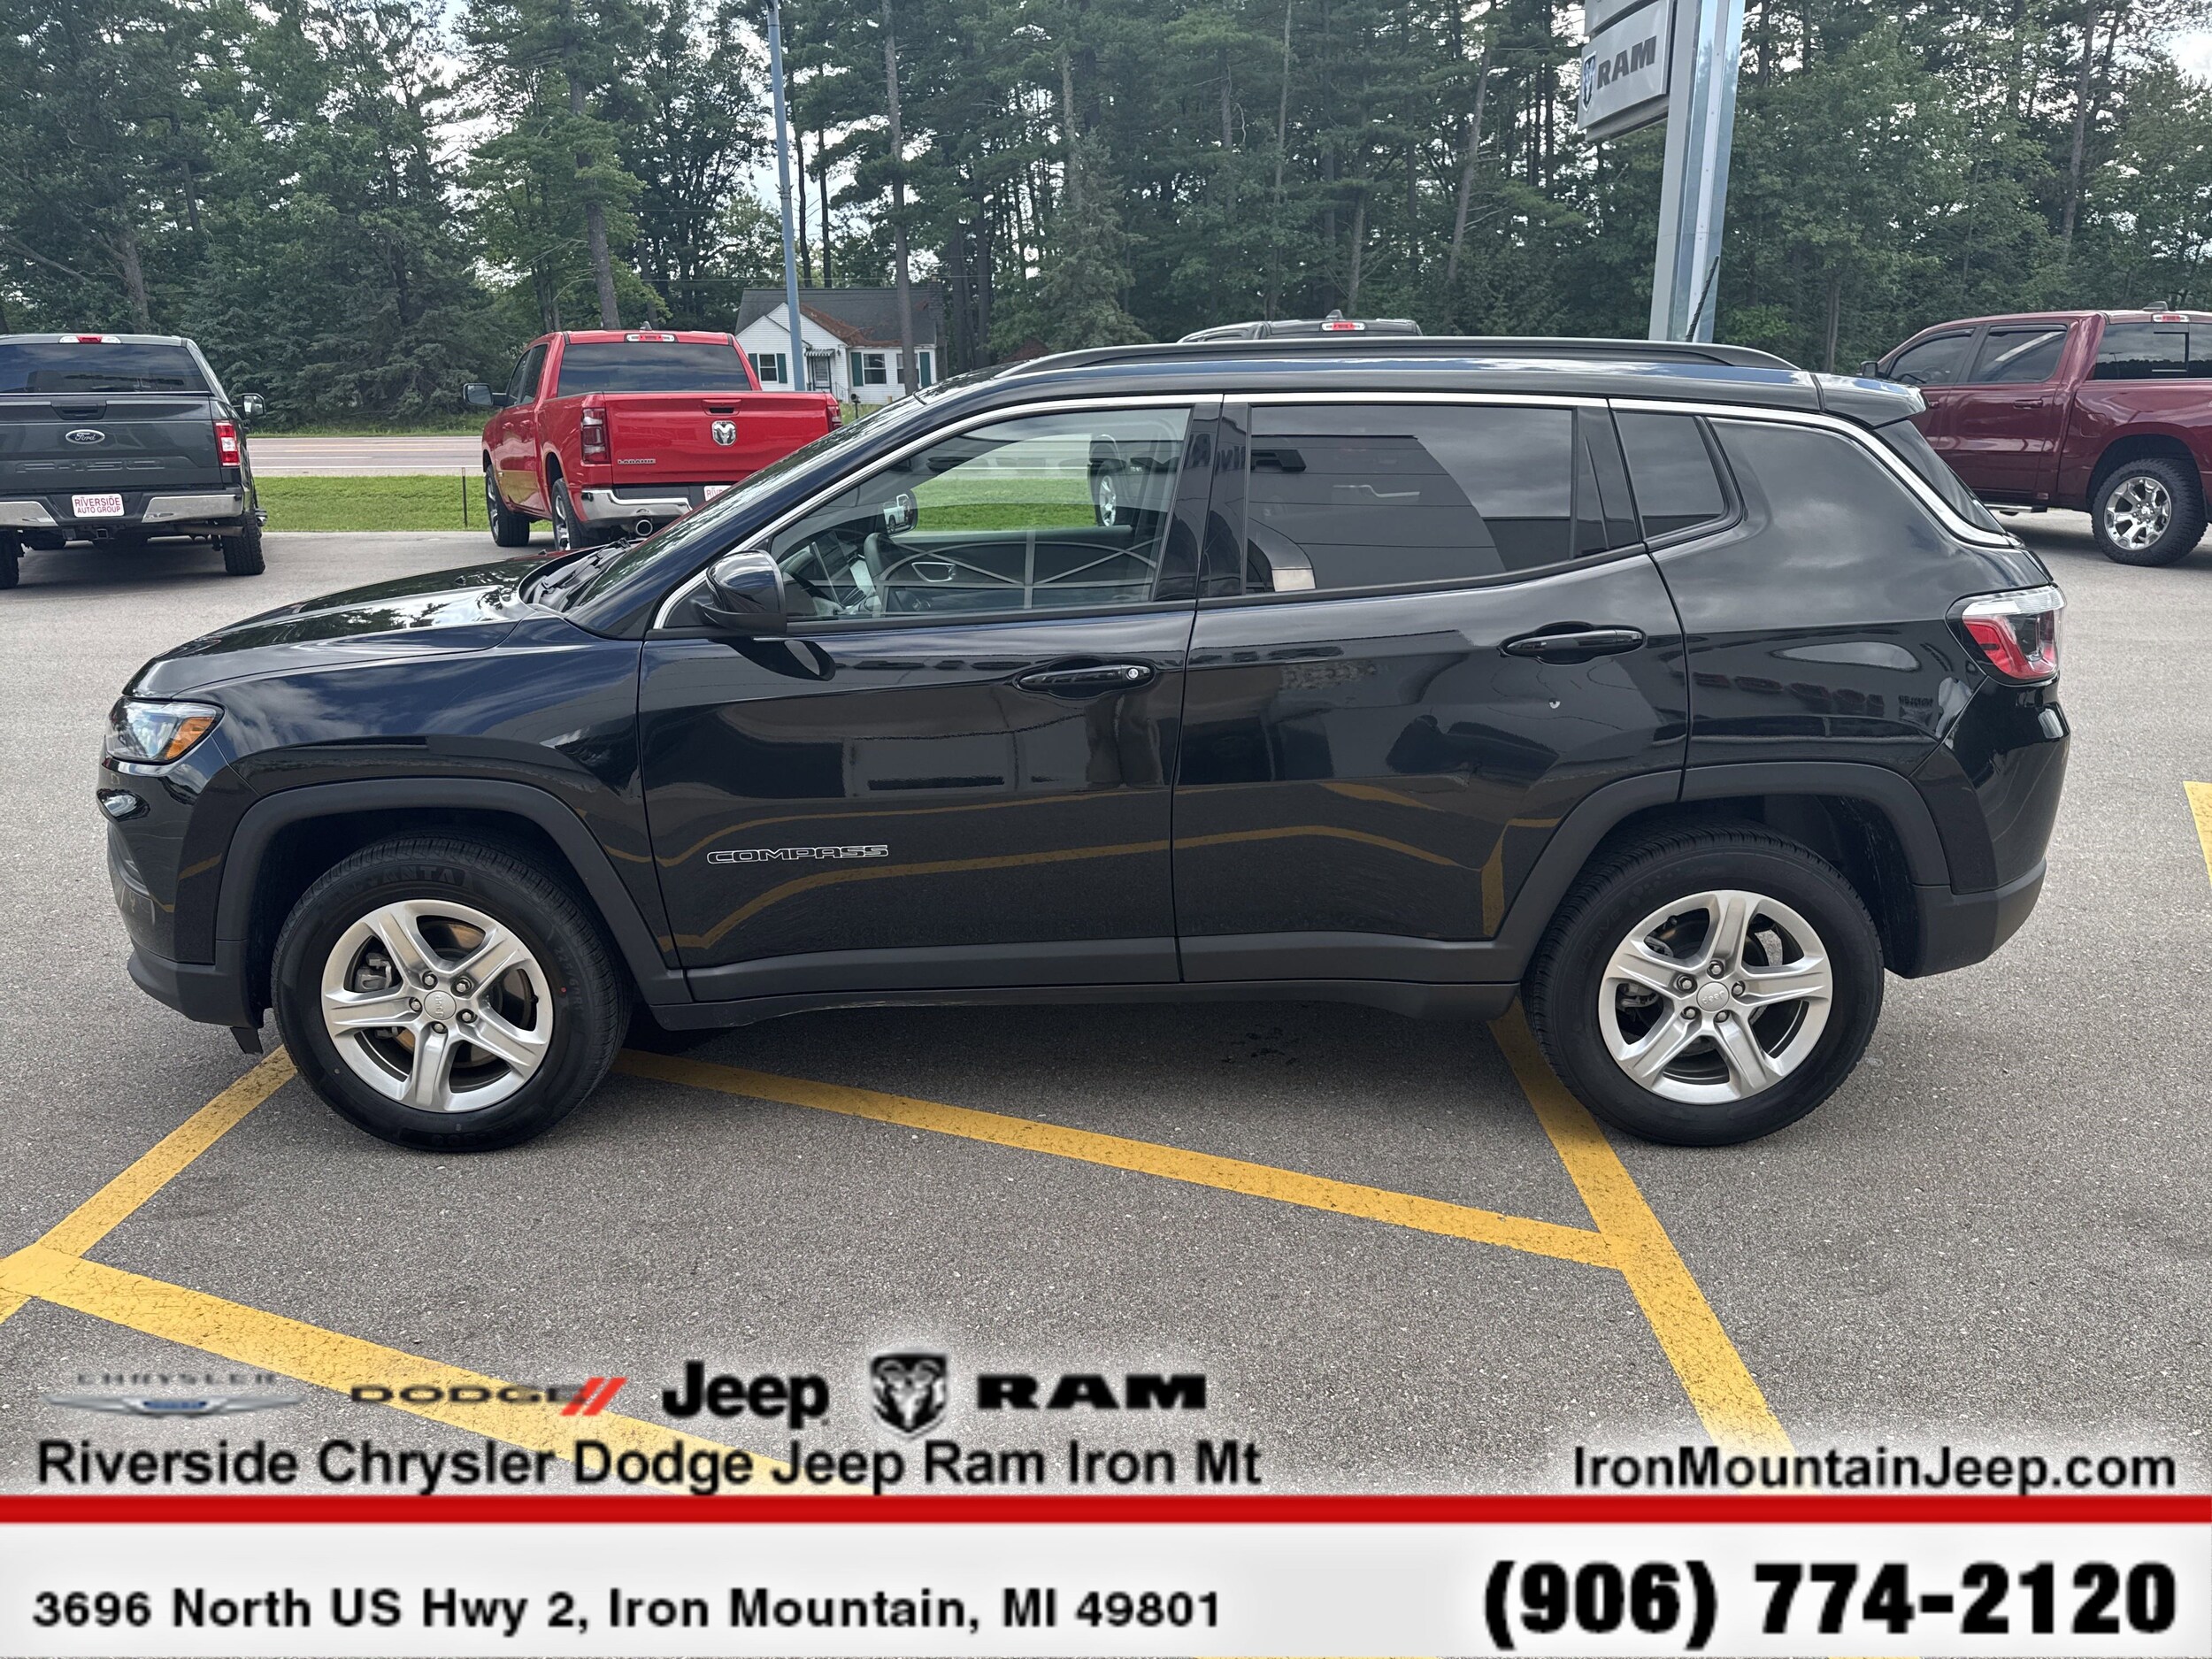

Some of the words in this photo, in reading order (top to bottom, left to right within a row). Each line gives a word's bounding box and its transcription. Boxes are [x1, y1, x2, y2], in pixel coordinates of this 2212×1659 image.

[1596, 35, 1657, 90] RAM
[74, 496, 121, 507] RIVERSIDE
[707, 844, 888, 864] COMPASS
